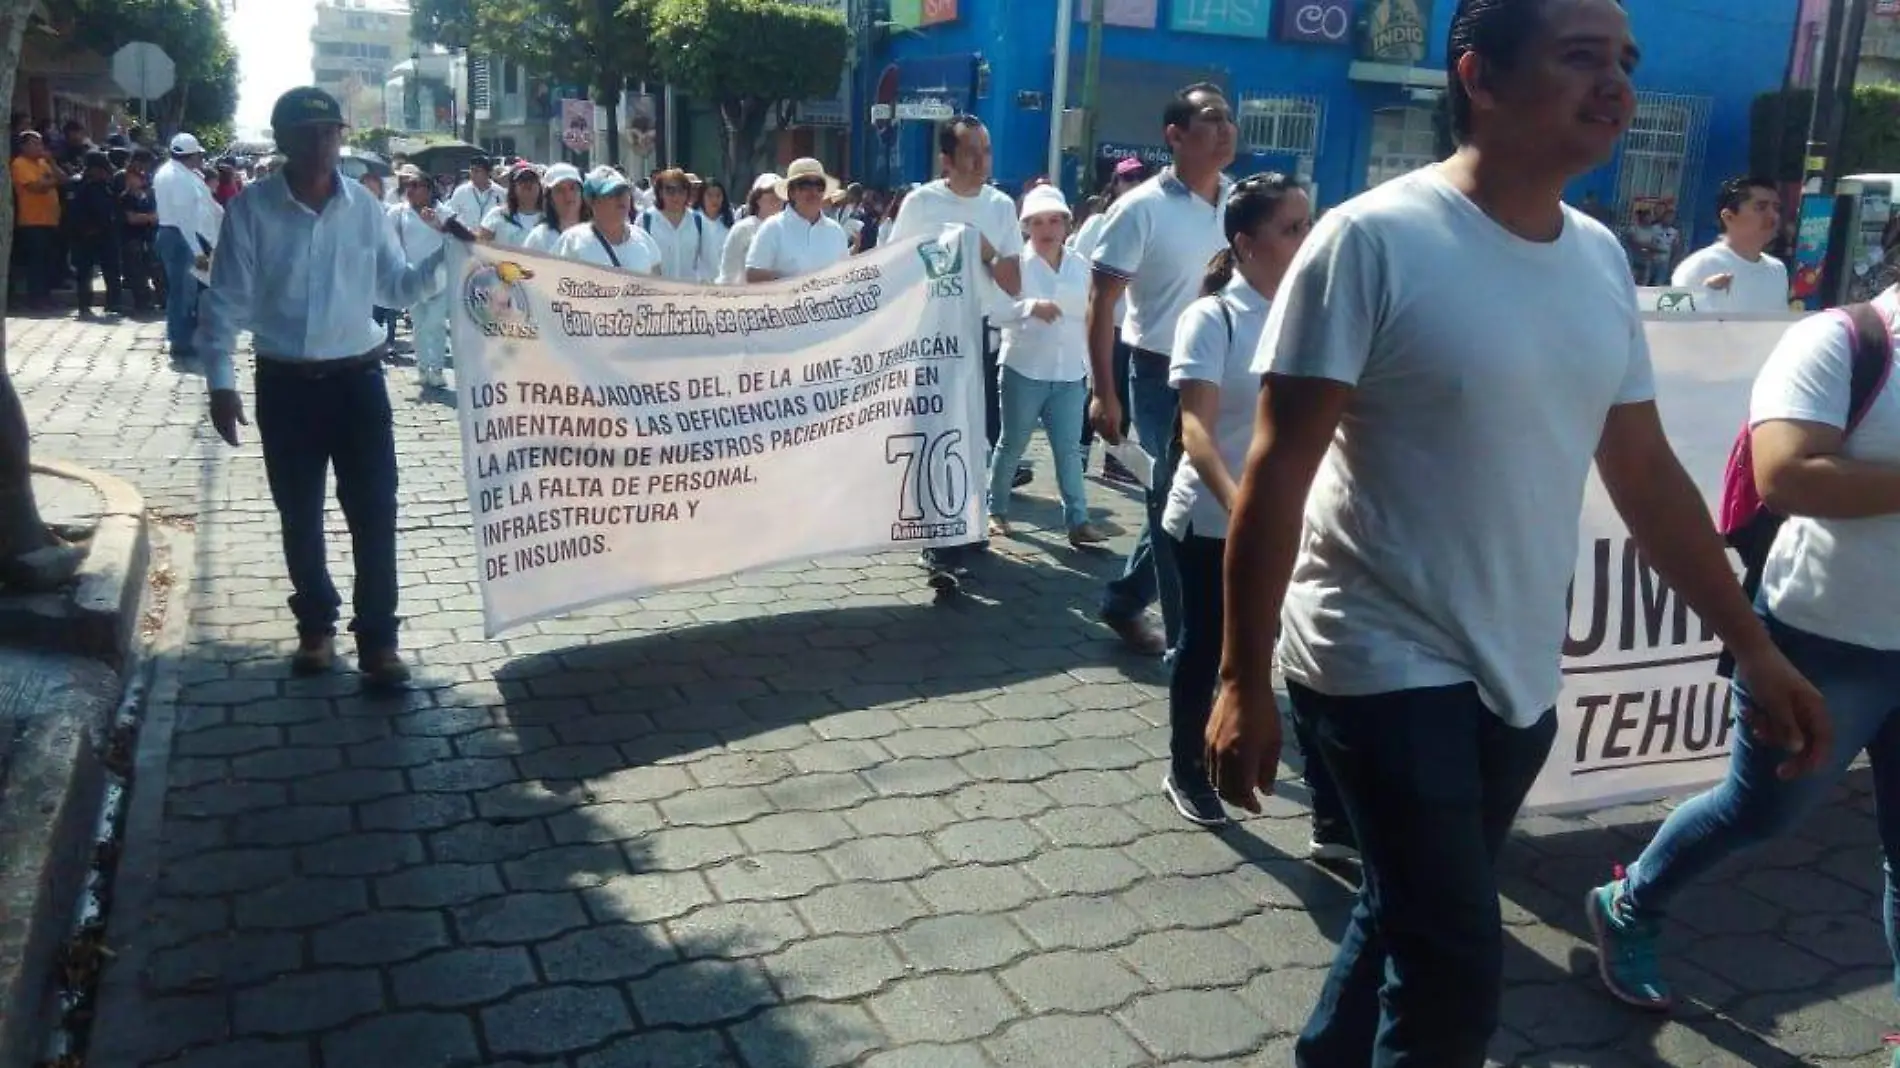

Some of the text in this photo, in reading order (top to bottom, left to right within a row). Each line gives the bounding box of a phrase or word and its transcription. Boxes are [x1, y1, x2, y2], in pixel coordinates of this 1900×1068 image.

[1373, 26, 1423, 51] INDIO
[594, 308, 633, 336] este
[715, 308, 737, 333] se
[738, 303, 784, 337] pacta
[471, 382, 508, 409] LOS
[516, 379, 681, 407] TRABAJADORES
[739, 371, 764, 394] DE
[770, 368, 791, 388] LA
[803, 353, 875, 383] UMF-30
[879, 333, 959, 370] TEHUACÁN
[474, 365, 939, 444] LAMENTAMOS LAS DEFICIENCIAS QUE EXISTEN EN
[478, 393, 944, 479] LA ATENCIÓN DE NUESTROS PACIENTES DERIVADO
[481, 486, 503, 513] DE
[509, 483, 533, 506] LA
[539, 476, 604, 500] FALTA
[612, 476, 641, 497] DE
[886, 429, 967, 520] 76
[483, 499, 701, 547] INFRAESTRUCTURA Y
[486, 534, 612, 582] DE INSUMOS.
[1562, 538, 1716, 657] UM
